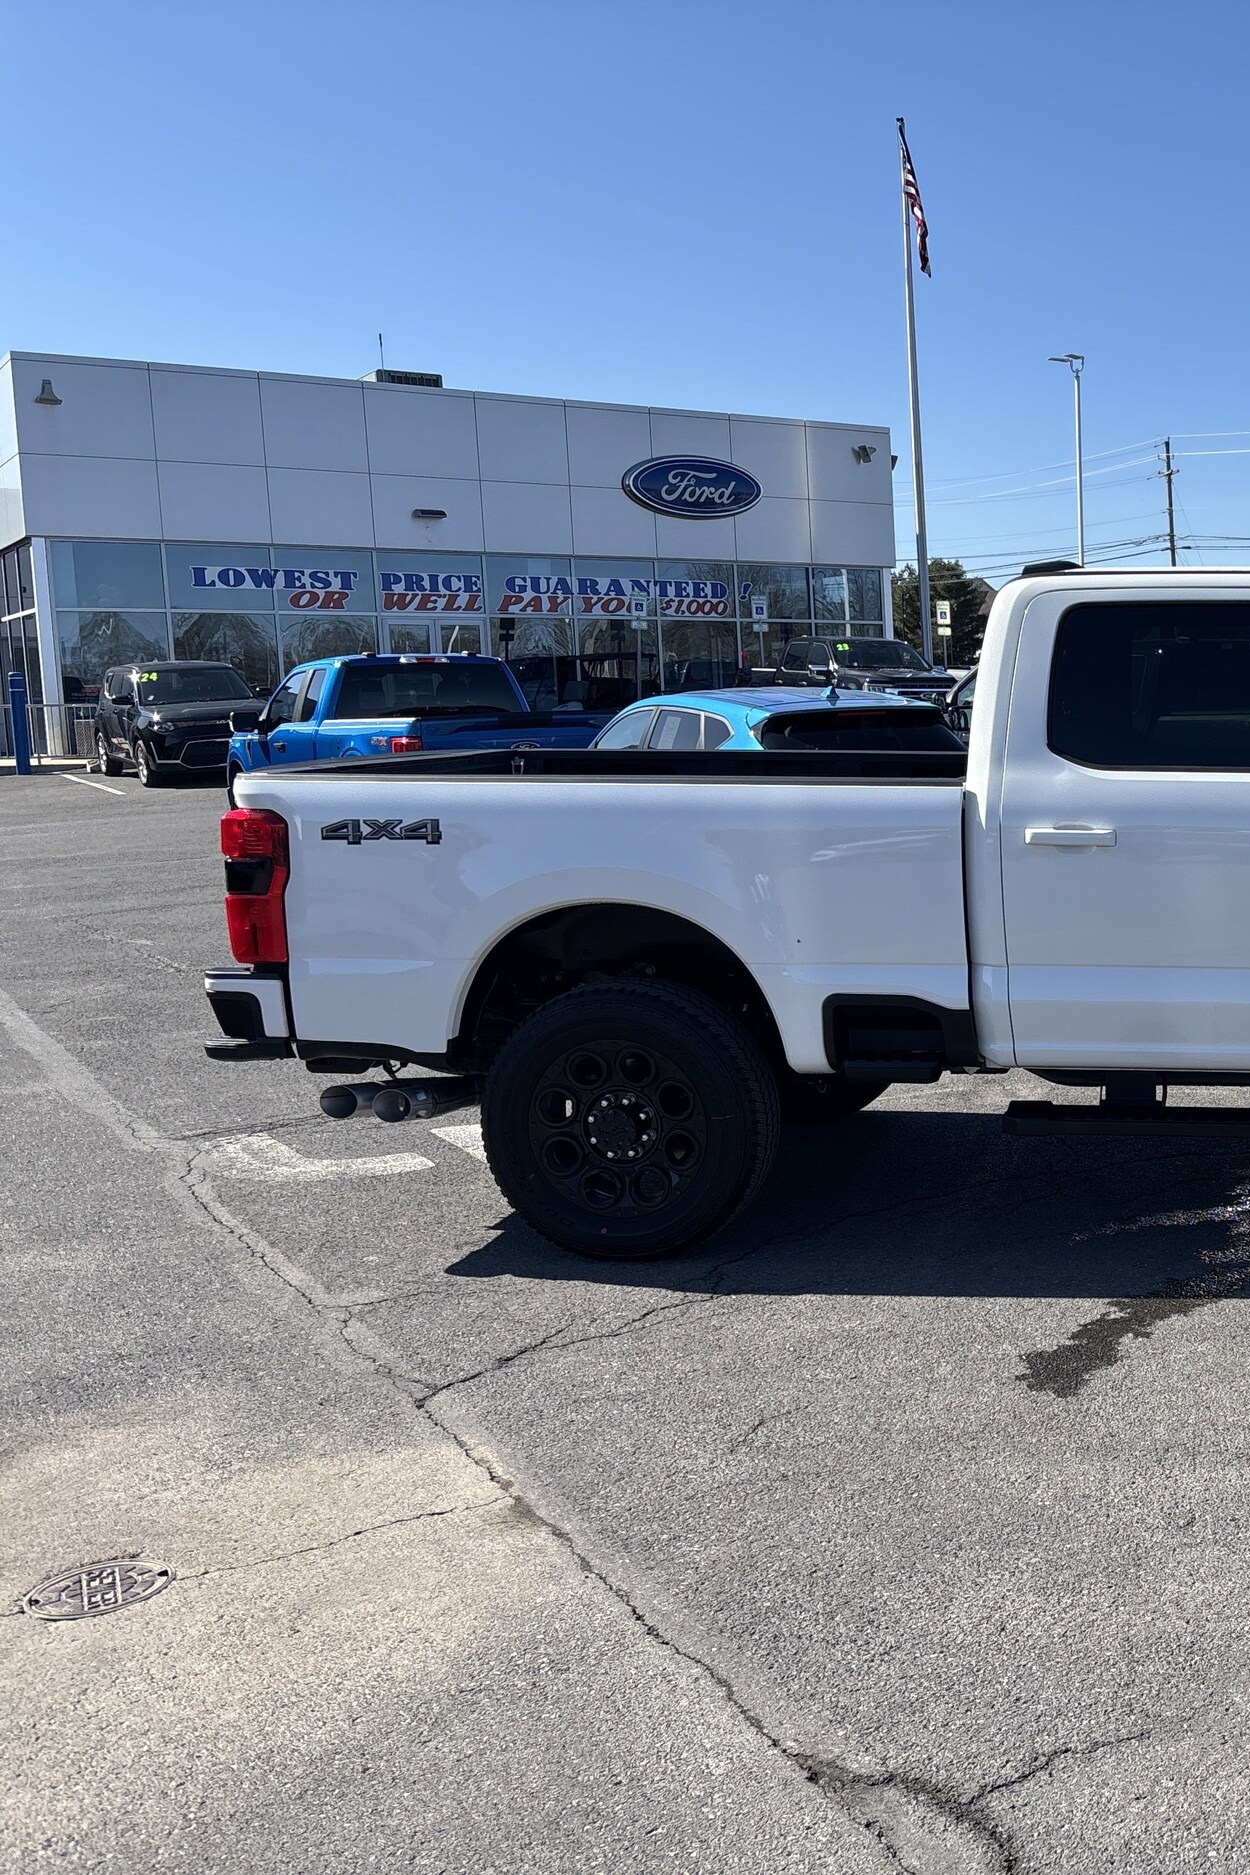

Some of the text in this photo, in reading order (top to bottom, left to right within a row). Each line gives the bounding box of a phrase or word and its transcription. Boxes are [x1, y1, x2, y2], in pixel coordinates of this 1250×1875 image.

[660, 469, 736, 505] Ford
[190, 566, 358, 591] LOWEST
[379, 571, 483, 594] PRICE
[504, 575, 729, 600] GUARANTEED
[288, 590, 350, 610] OR
[497, 594, 569, 613] PAY
[659, 598, 730, 617] $1,000
[836, 643, 850, 651] 23
[140, 672, 158, 682] 24
